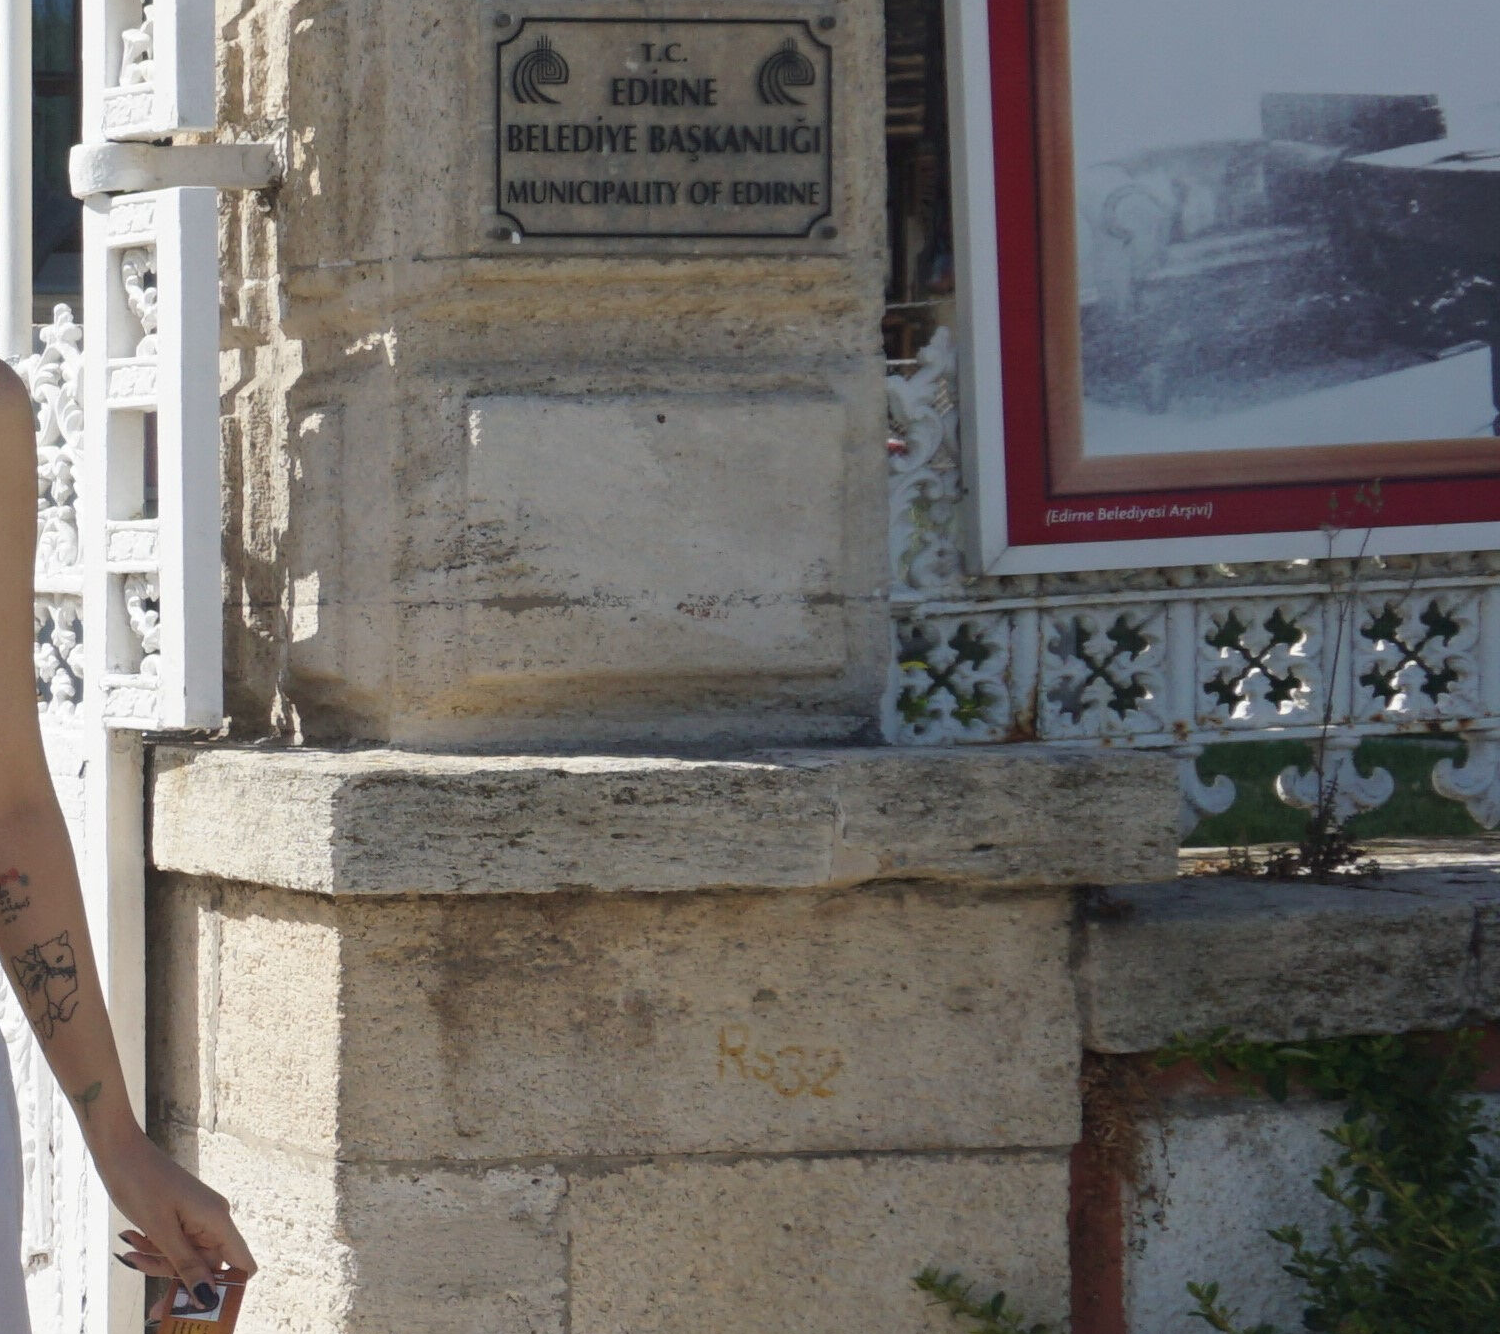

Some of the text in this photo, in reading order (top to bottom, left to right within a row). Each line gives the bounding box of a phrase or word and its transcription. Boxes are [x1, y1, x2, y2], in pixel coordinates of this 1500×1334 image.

[640, 42, 688, 63] T.C.
[610, 69, 718, 107] EDİRNE
[507, 116, 821, 163] BELEDİYE BAŞKANLIĞI
[507, 180, 820, 206] MUNICIPALITY OF EDIRNE
[1046, 508, 1095, 527] (Edirne
[1098, 504, 1167, 523] Belediyesi
